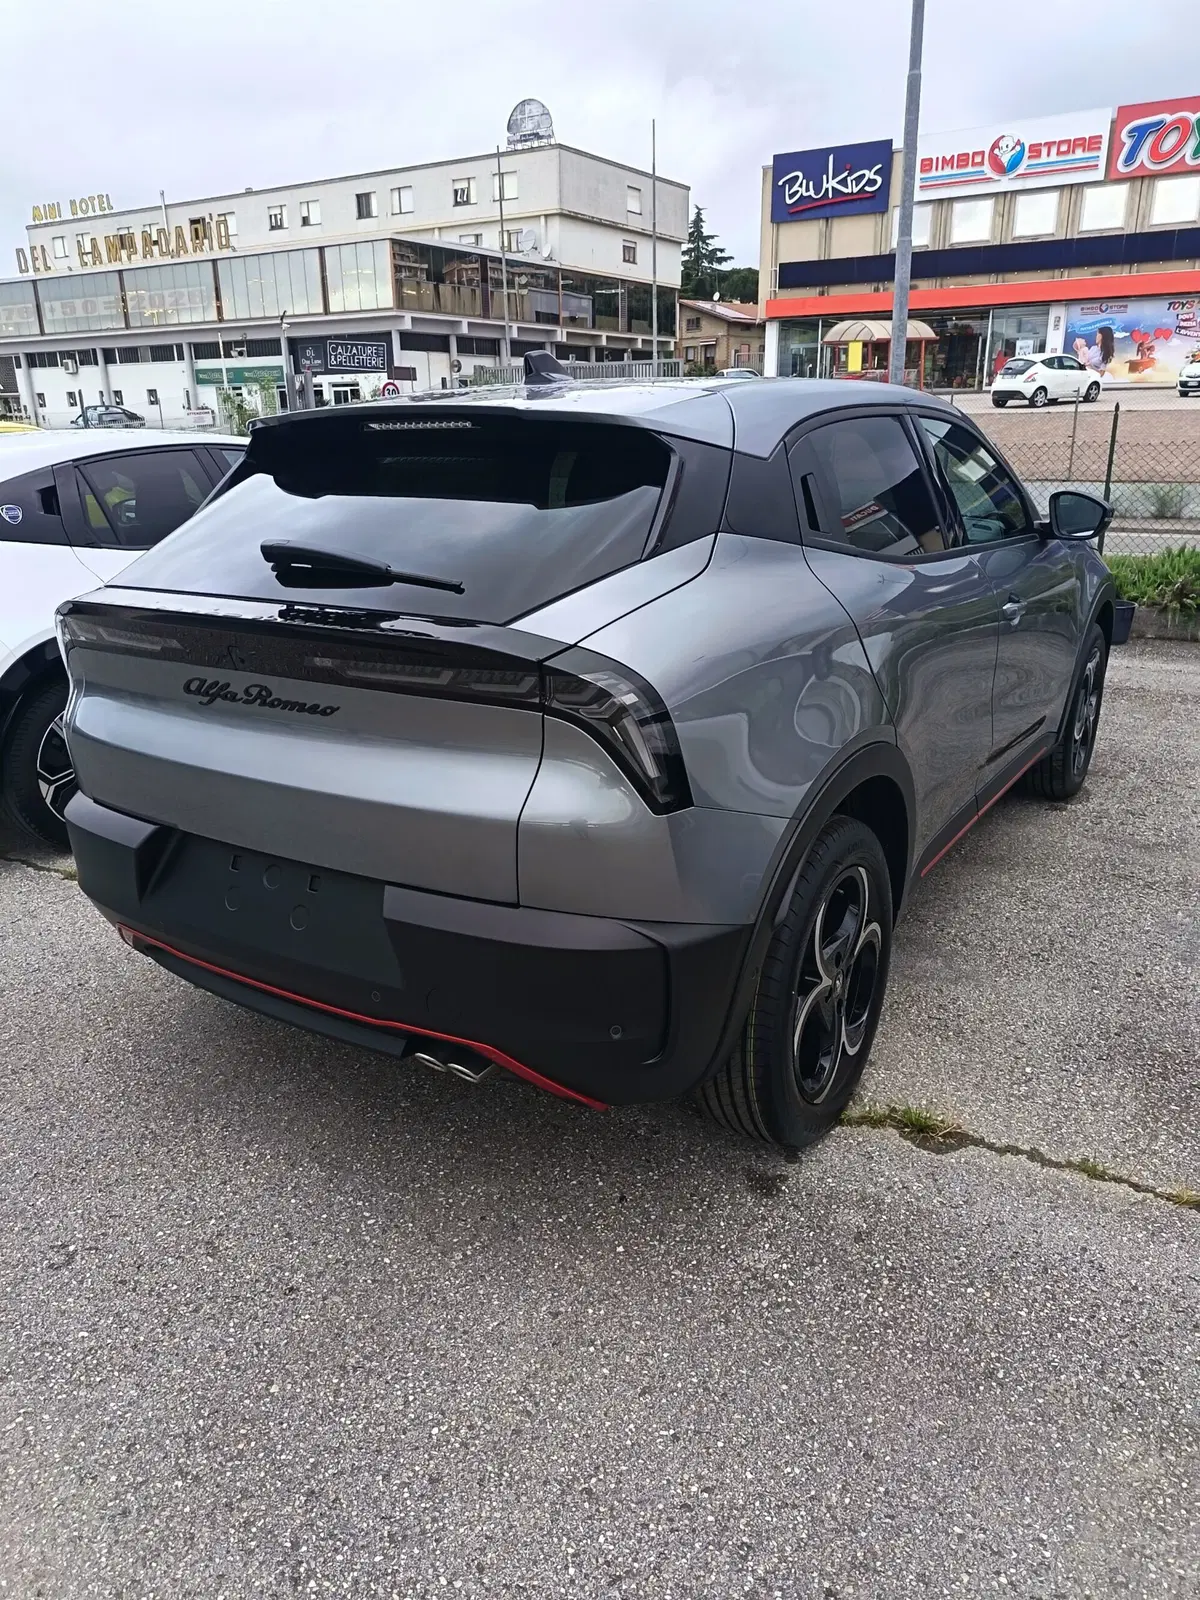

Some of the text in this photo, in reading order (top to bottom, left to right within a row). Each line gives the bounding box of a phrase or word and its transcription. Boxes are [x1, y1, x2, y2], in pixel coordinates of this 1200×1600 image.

[919, 134, 1104, 174] BIMBO STORE
[1122, 114, 1200, 168] TO
[32, 193, 114, 222] MINI HOTEL
[15, 244, 52, 274] DEL
[1166, 300, 1196, 312] TOYS
[329, 344, 378, 357] CALZATURE
[386, 388, 397, 396] 30
[182, 676, 342, 717] Alfa Romeo
